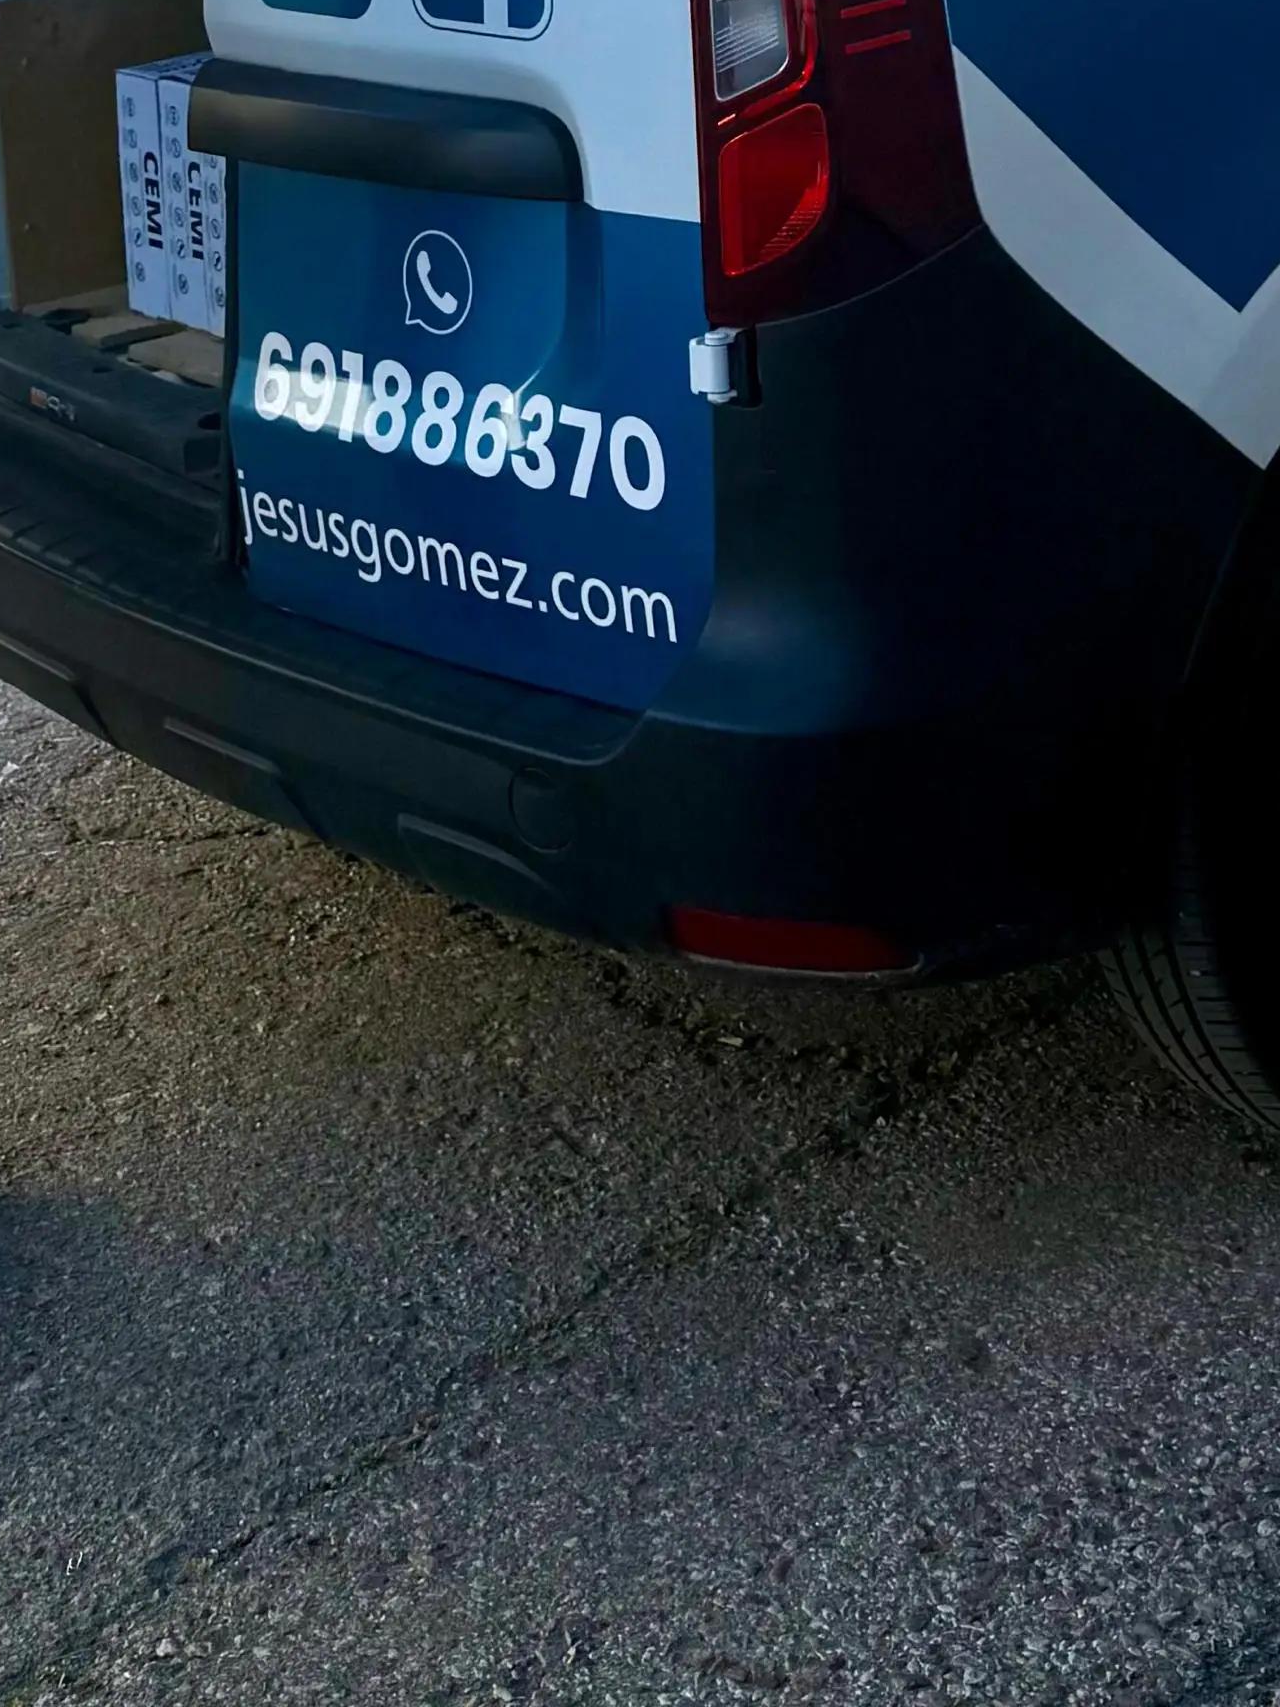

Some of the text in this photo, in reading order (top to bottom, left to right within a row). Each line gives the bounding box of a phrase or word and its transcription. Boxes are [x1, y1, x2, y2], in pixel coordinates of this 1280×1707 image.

[143, 150, 164, 250] CEMI
[253, 331, 665, 511] 691886370
[237, 470, 678, 643] jesusgomez.com
